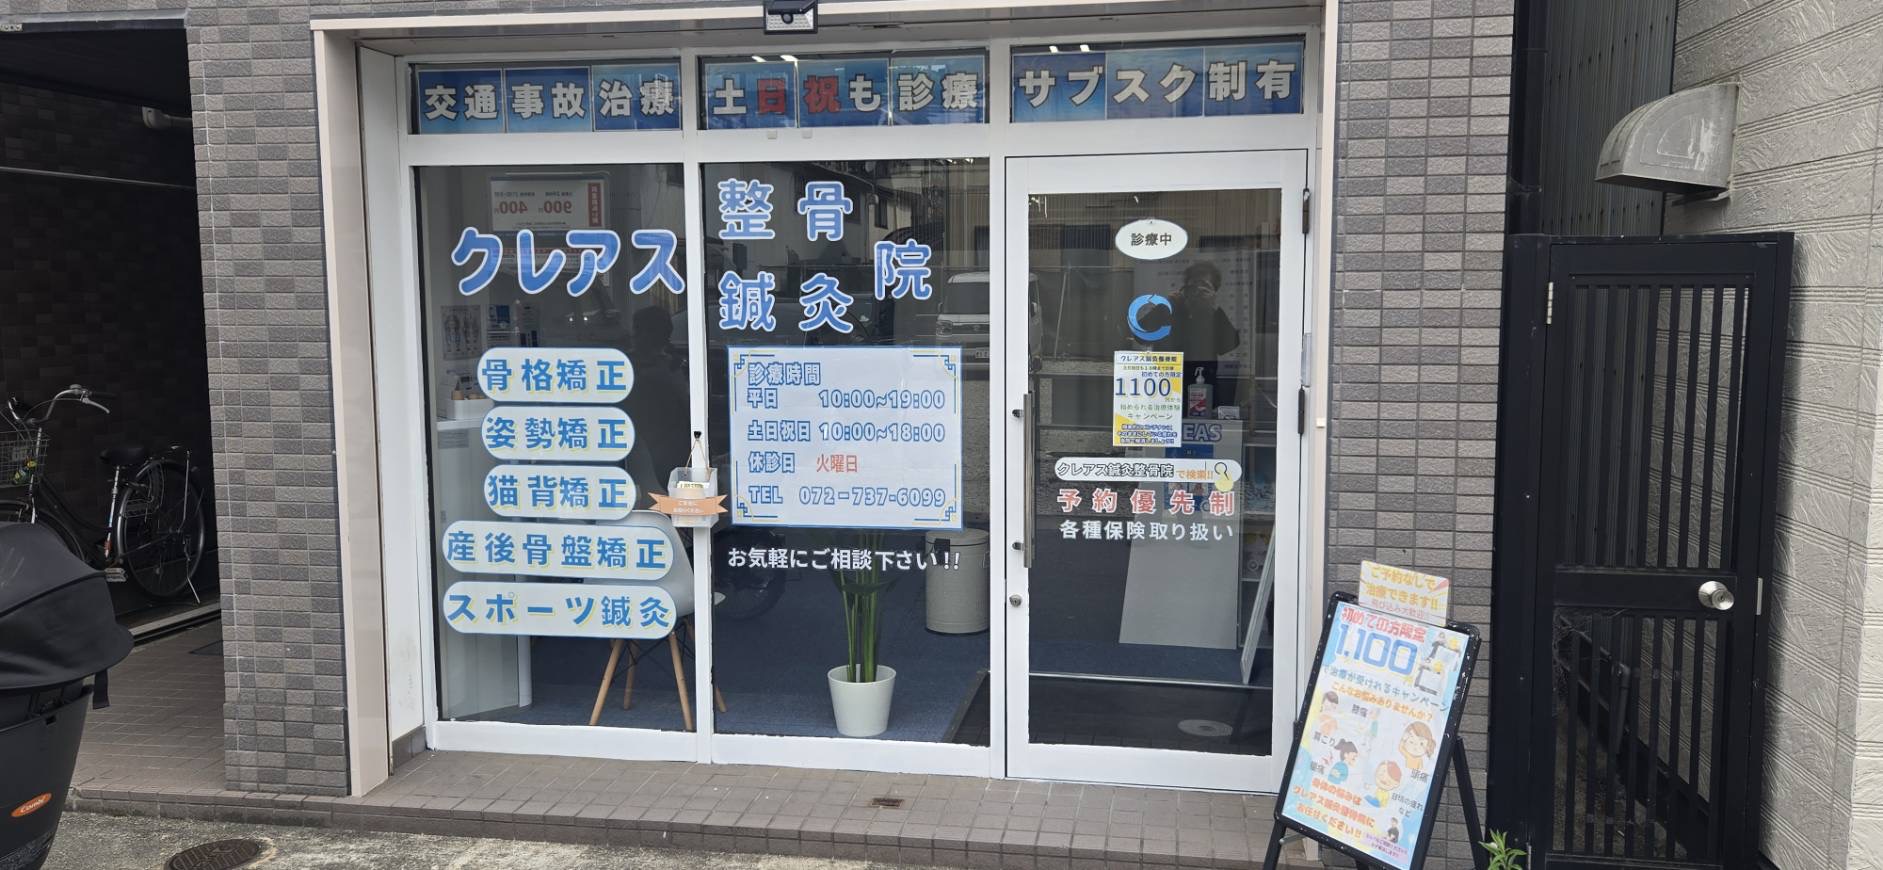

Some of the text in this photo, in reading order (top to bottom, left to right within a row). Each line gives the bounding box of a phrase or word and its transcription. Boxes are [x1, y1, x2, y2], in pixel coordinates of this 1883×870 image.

[424, 72, 676, 121] 交通事故治療
[712, 72, 979, 116] 土日祝も診療
[1018, 59, 1296, 108] サブスク制有
[1131, 233, 1172, 246] 診療中
[451, 226, 685, 297] クレアス
[481, 358, 628, 392] 骨格矯正
[748, 362, 821, 386] 診療時間
[1115, 378, 1171, 396] 1100
[747, 387, 778, 409] 平日
[486, 416, 628, 450] 姿勢矯正
[747, 420, 811, 442] 土日祝日
[748, 452, 859, 473] 休診日 火曜日
[1057, 462, 1174, 477] クレアス鍼灸整骨院
[487, 474, 629, 509] 猫背矯正
[748, 485, 783, 504] TEL
[1057, 487, 1235, 516] 予約優先制
[1060, 519, 1233, 541] 各種保険取り扱い
[447, 530, 667, 570] 産後骨盤矯正
[447, 592, 670, 628] スポーツ鍼灸
[1342, 606, 1428, 643] 初めての方限定
